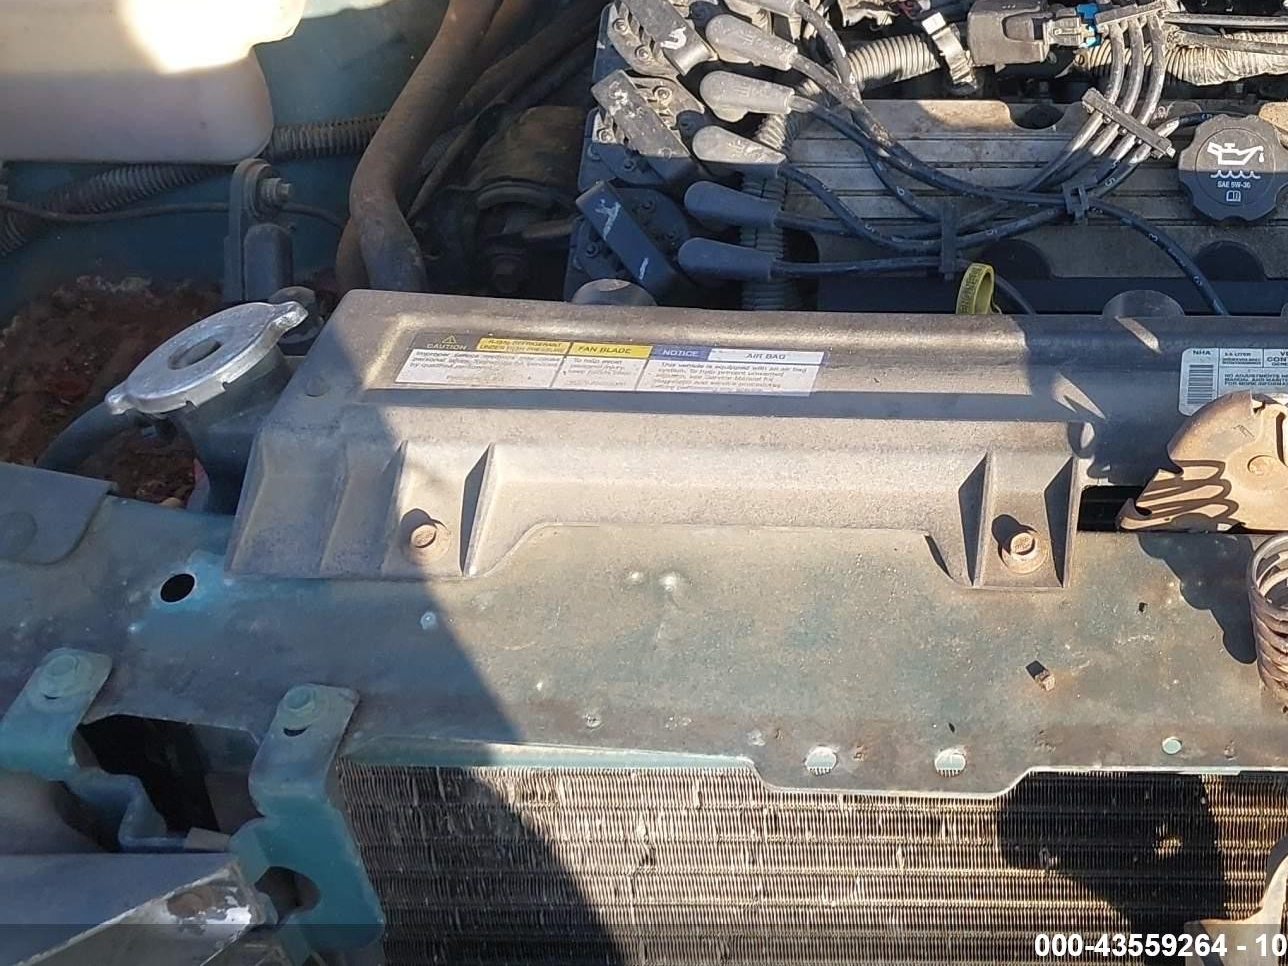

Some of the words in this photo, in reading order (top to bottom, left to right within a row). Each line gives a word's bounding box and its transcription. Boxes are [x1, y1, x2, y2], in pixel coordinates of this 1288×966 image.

[426, 343, 468, 351] CAUTION
[600, 346, 632, 354] BLADE
[662, 349, 700, 357] NOTICE
